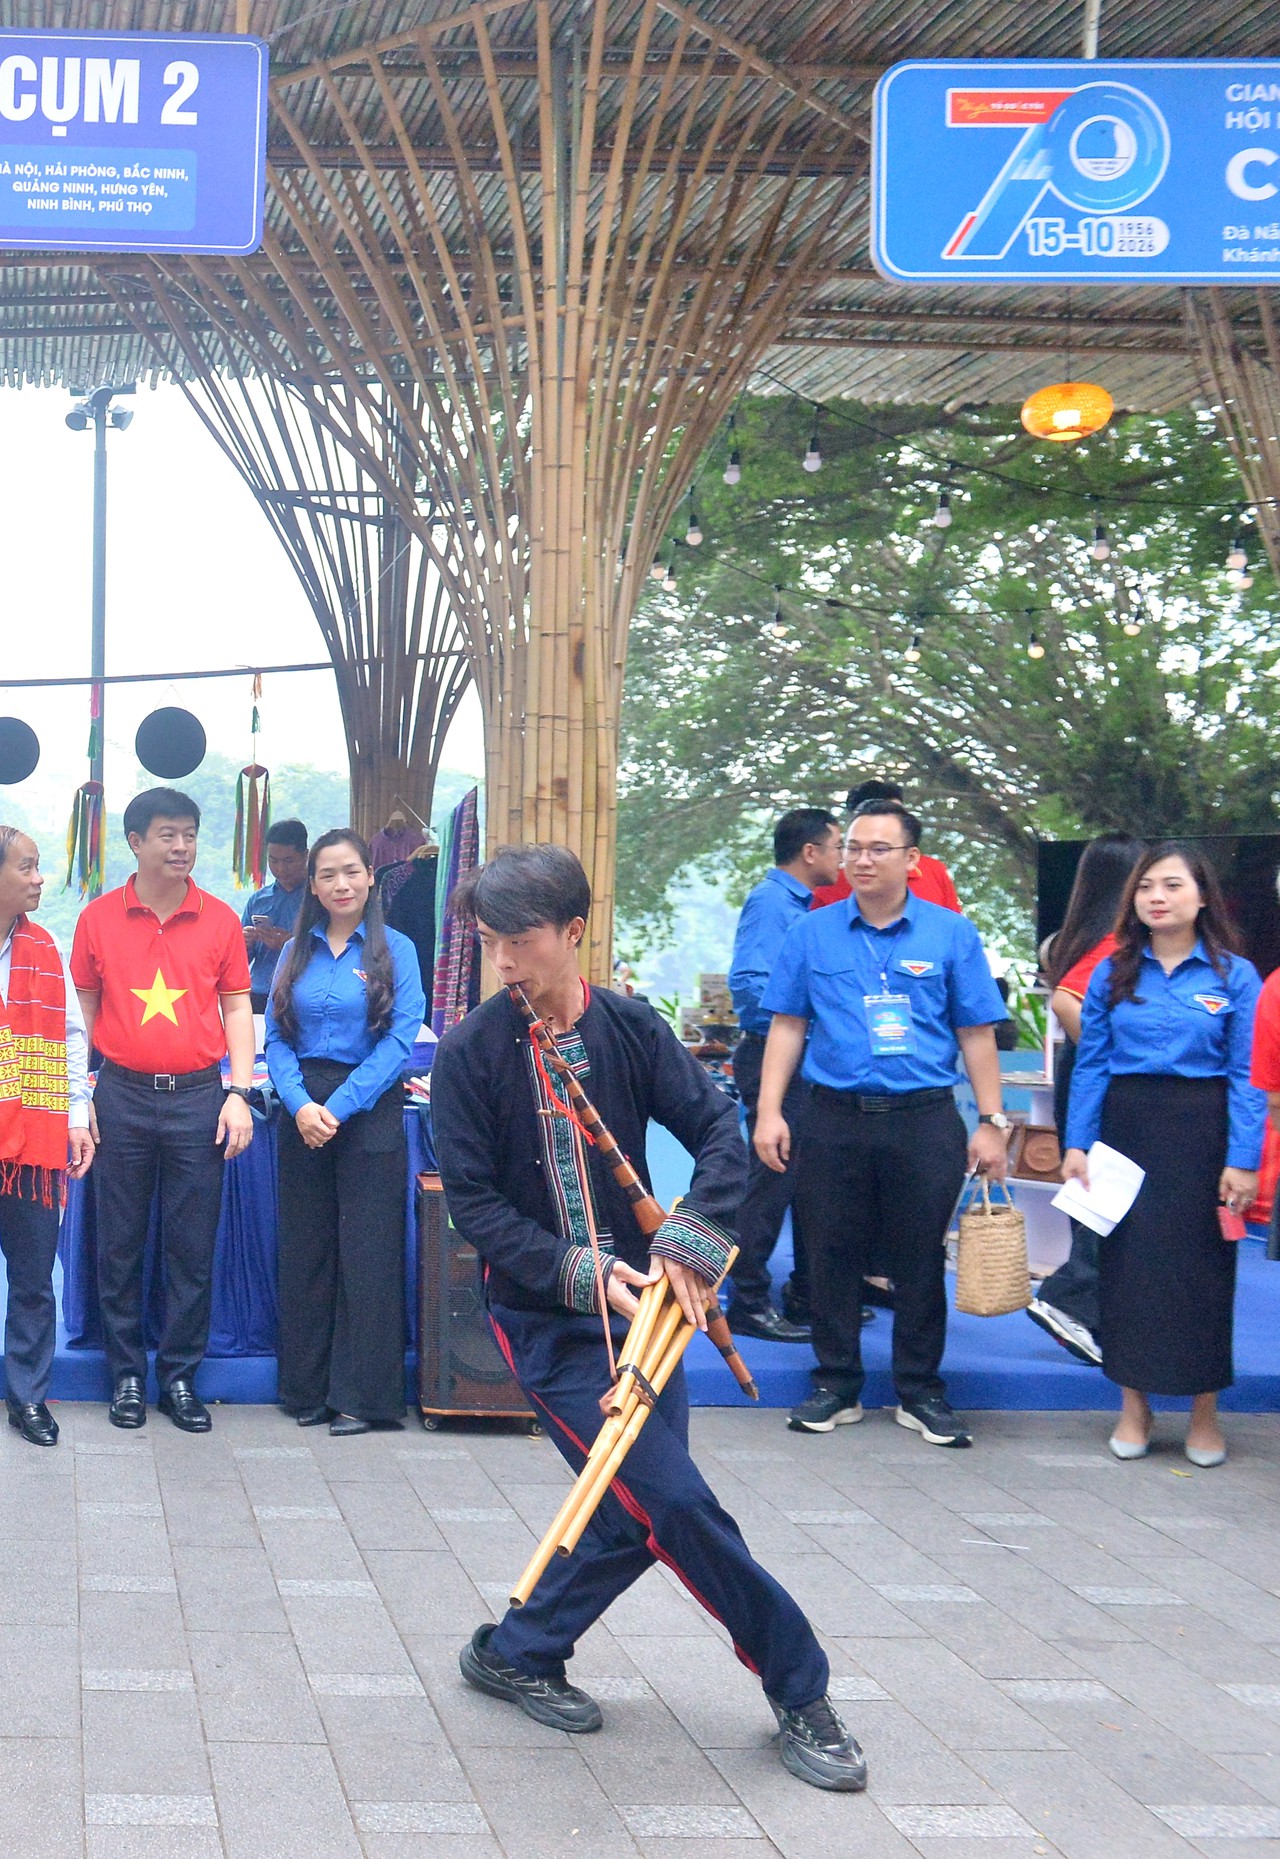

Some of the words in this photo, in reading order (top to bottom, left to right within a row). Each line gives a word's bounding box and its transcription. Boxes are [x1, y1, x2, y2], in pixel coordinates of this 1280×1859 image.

[160, 60, 200, 125] 2
[1225, 106, 1271, 133] HỘI
[14, 163, 42, 178] NỘI,
[45, 162, 67, 176] HẢI
[70, 163, 120, 179] PHÒNG,
[123, 163, 151, 179] BẮC
[154, 168, 189, 181] NINH,
[12, 178, 60, 193] QUẢNG
[63, 182, 98, 196] NINH,
[101, 184, 138, 195] HƯNG
[141, 182, 169, 198] YÊN,
[27, 199, 58, 210] NINH
[61, 198, 95, 213] BÌNH,
[98, 198, 124, 212] PHÚ
[127, 201, 153, 215] THỌ
[1029, 219, 1116, 254] 15-10
[1118, 222, 1155, 236] 1956
[1222, 225, 1250, 240] Đà
[1118, 239, 1156, 252] 2026
